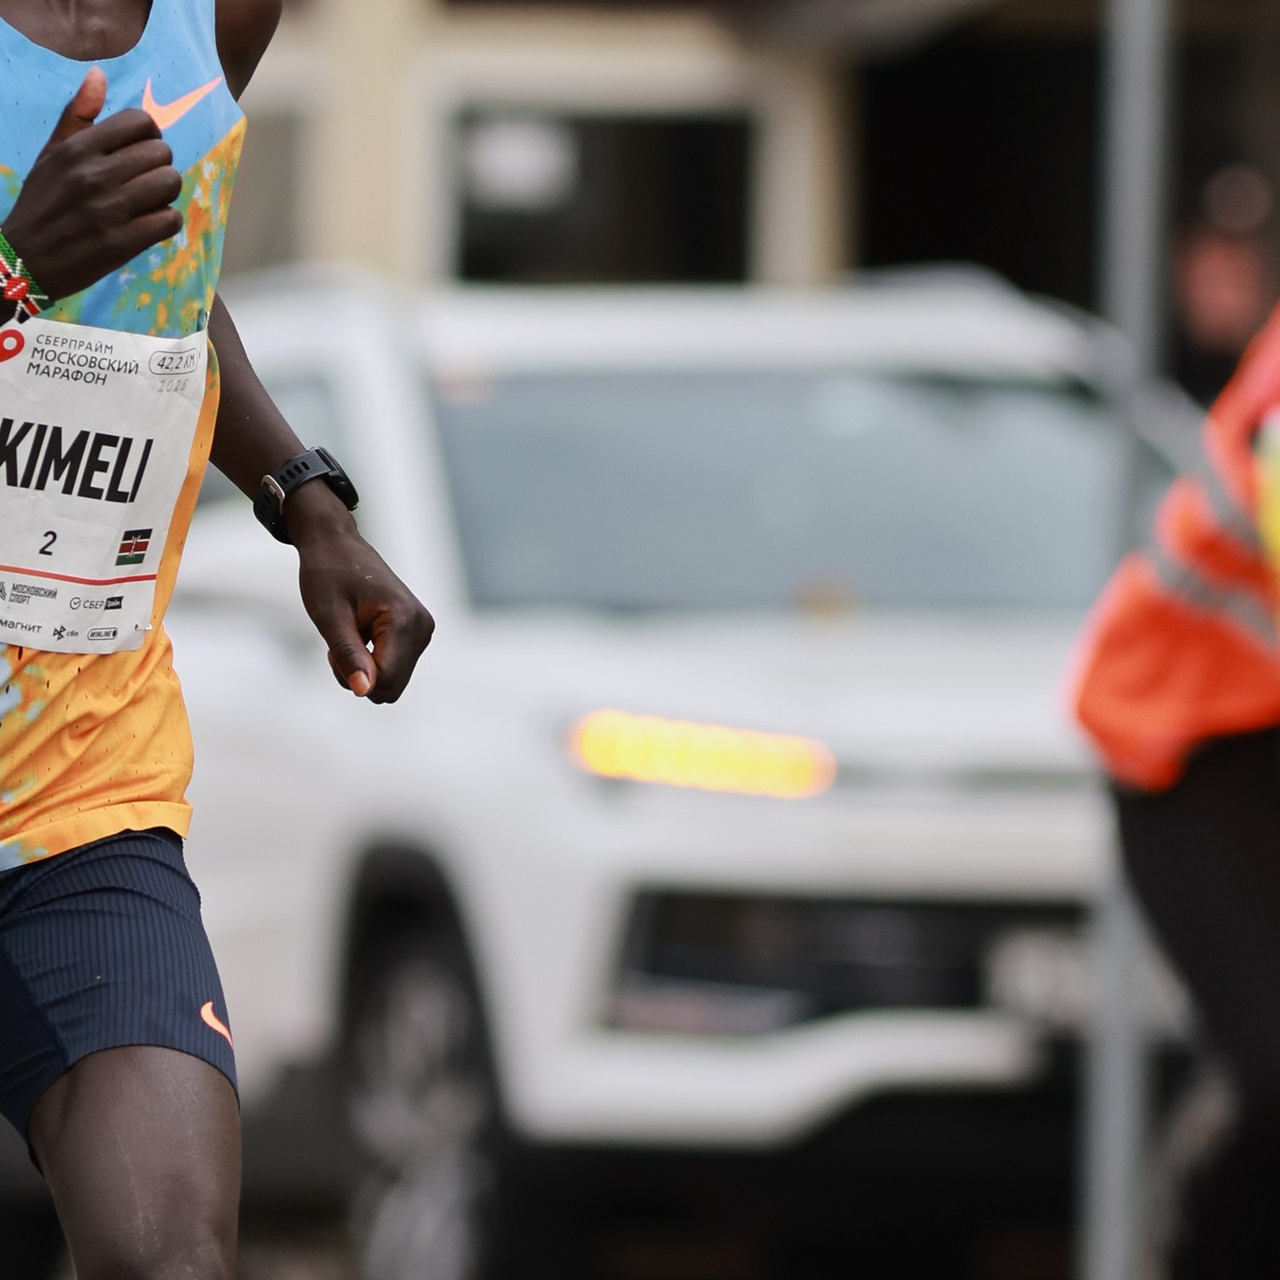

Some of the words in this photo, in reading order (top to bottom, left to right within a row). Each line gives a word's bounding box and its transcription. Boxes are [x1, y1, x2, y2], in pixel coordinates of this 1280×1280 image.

[35, 334, 114, 355] СБЕРПРАЙМ
[30, 347, 139, 375] МОСКОВСКИЙ
[157, 356, 183, 371] 42,2
[26, 362, 108, 386] МАРАФОН
[38, 530, 58, 556] 2
[8, 593, 32, 605] СПОРТ
[10, 582, 58, 599] МОСКОВСКИЙ
[82, 600, 105, 609] СБЕР
